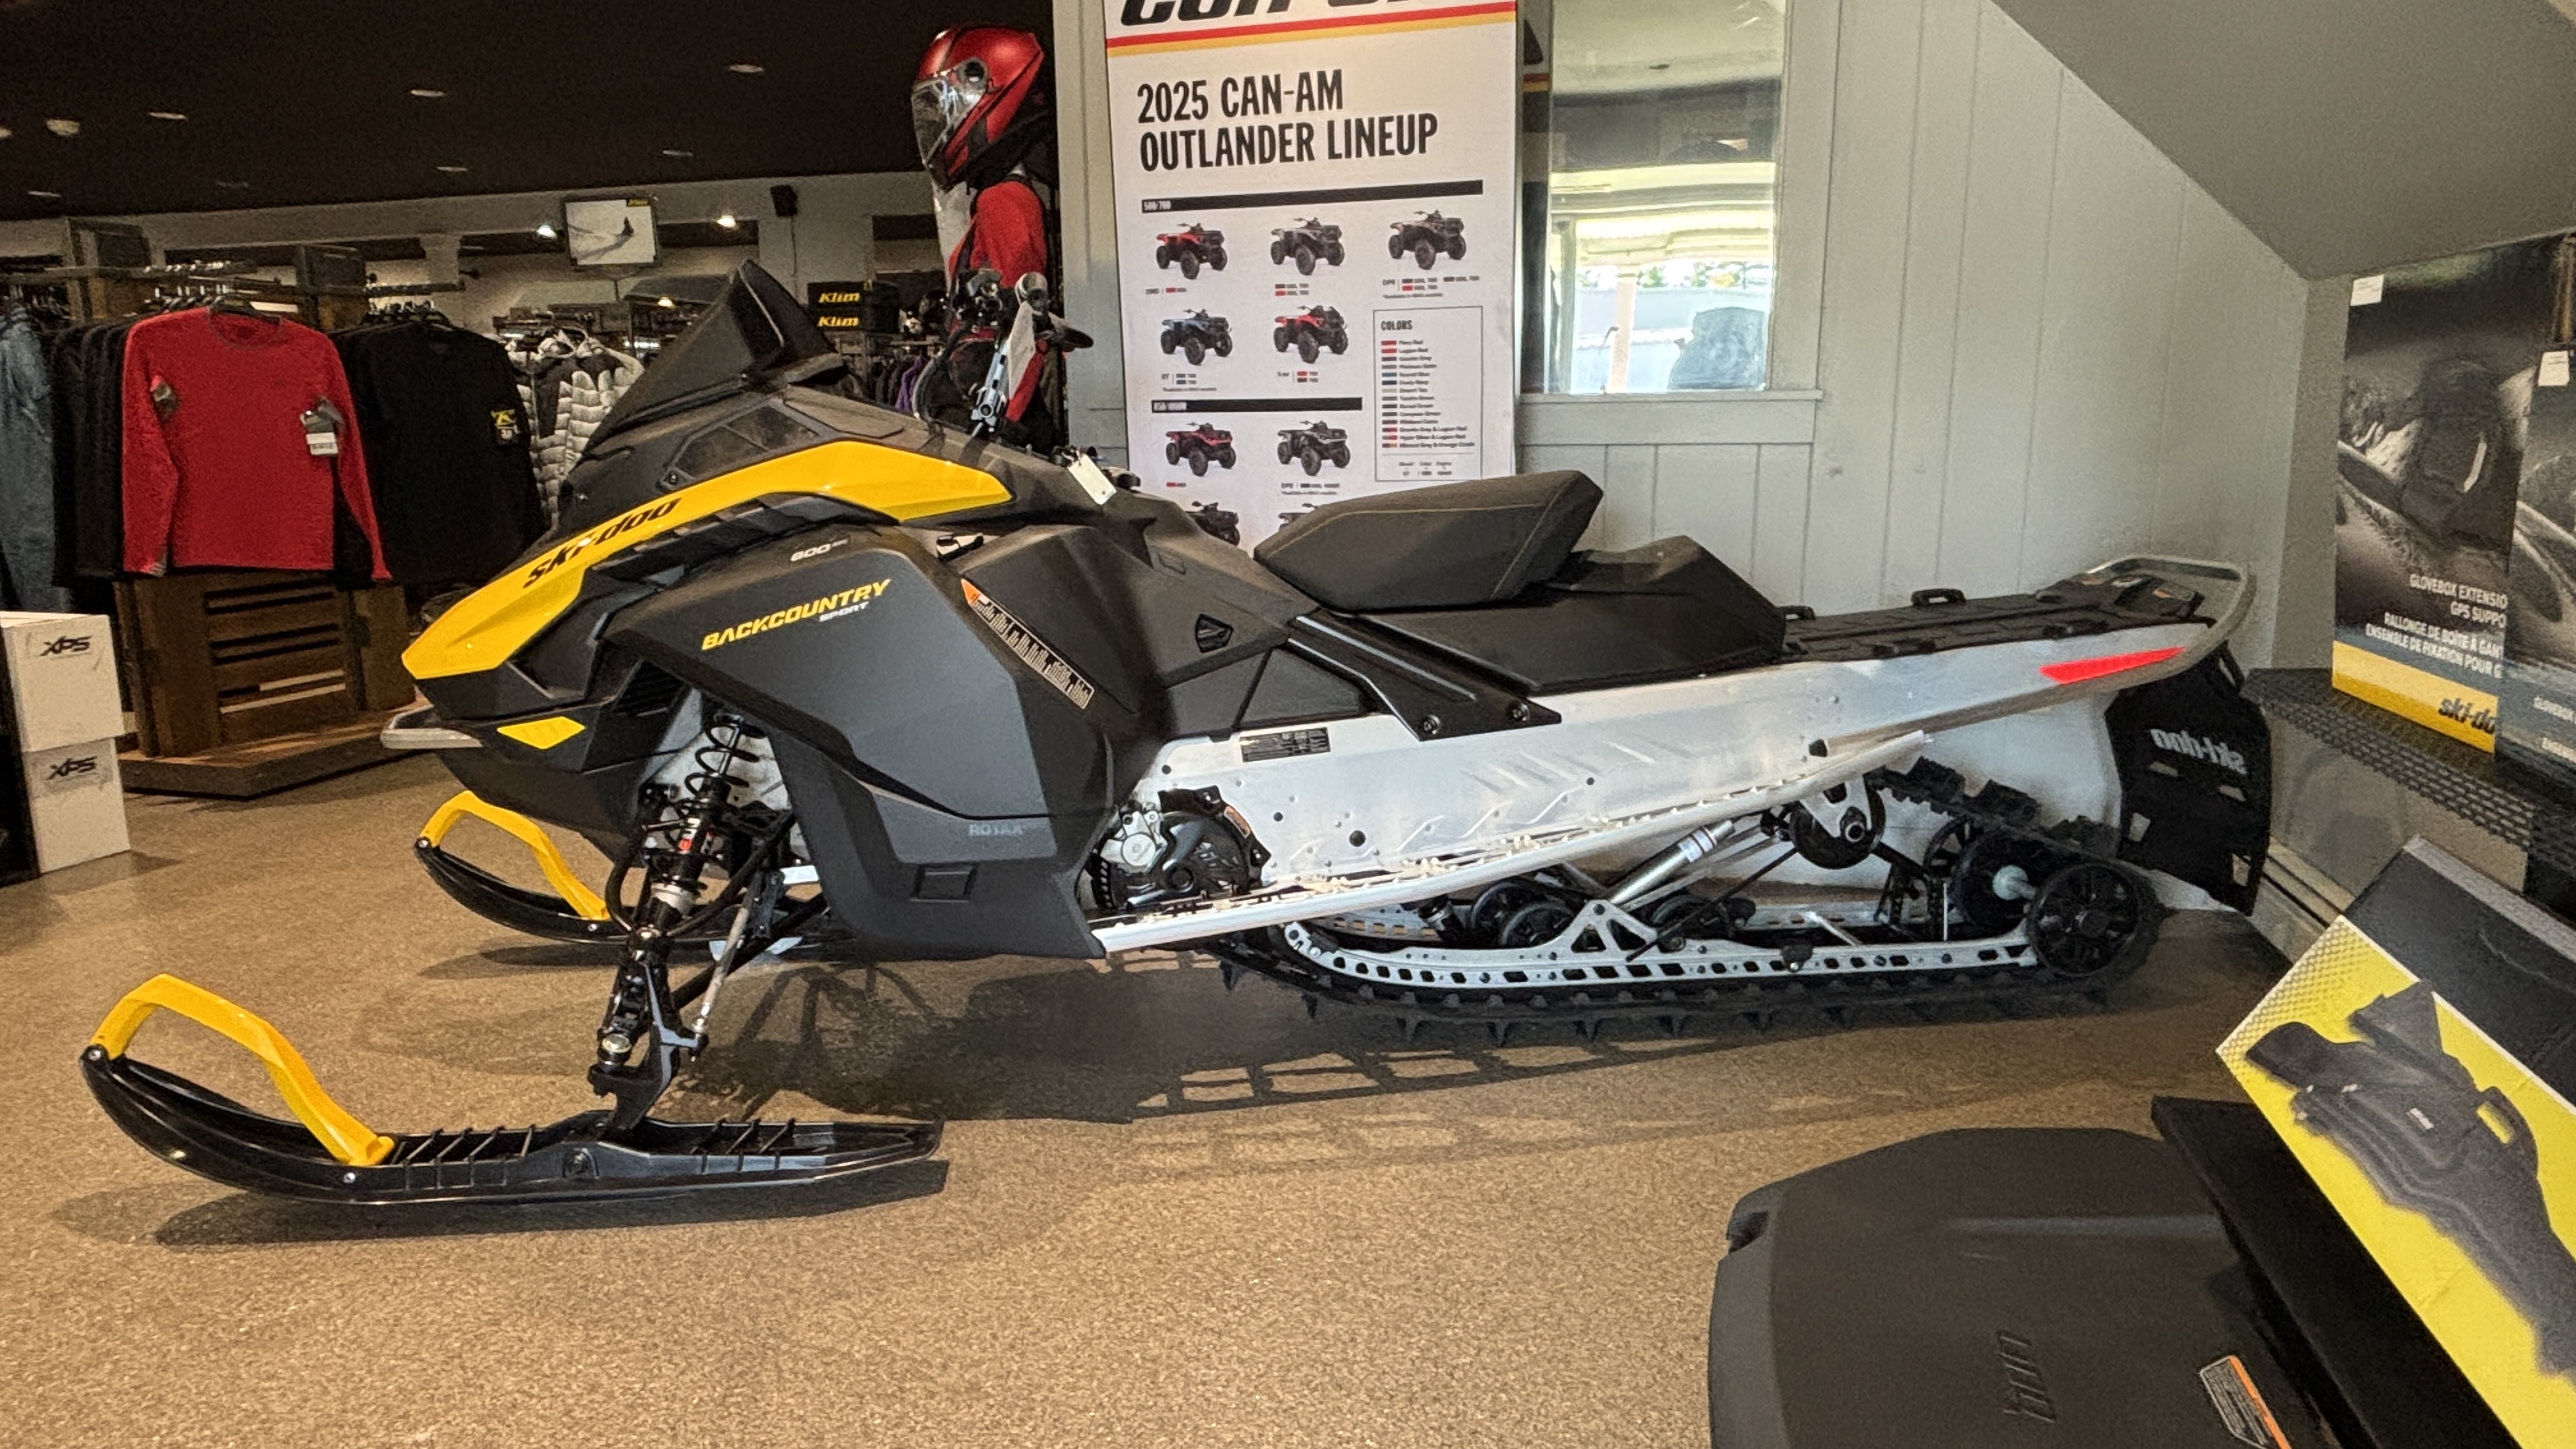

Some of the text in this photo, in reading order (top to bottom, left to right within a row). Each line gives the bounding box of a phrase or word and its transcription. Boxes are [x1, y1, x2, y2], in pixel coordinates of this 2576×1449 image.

[1137, 68, 1343, 123] 2025 CAN-AM
[1140, 113, 1438, 171] OUTLANDER LINEUP
[1381, 320, 1413, 331] COLORS
[2409, 574, 2457, 597] GLOVEBOX
[702, 578, 892, 650] BACKCOUNTRY
[2451, 601, 2471, 619] GPS
[40, 635, 92, 657] XPS
[46, 756, 97, 781] XPS
